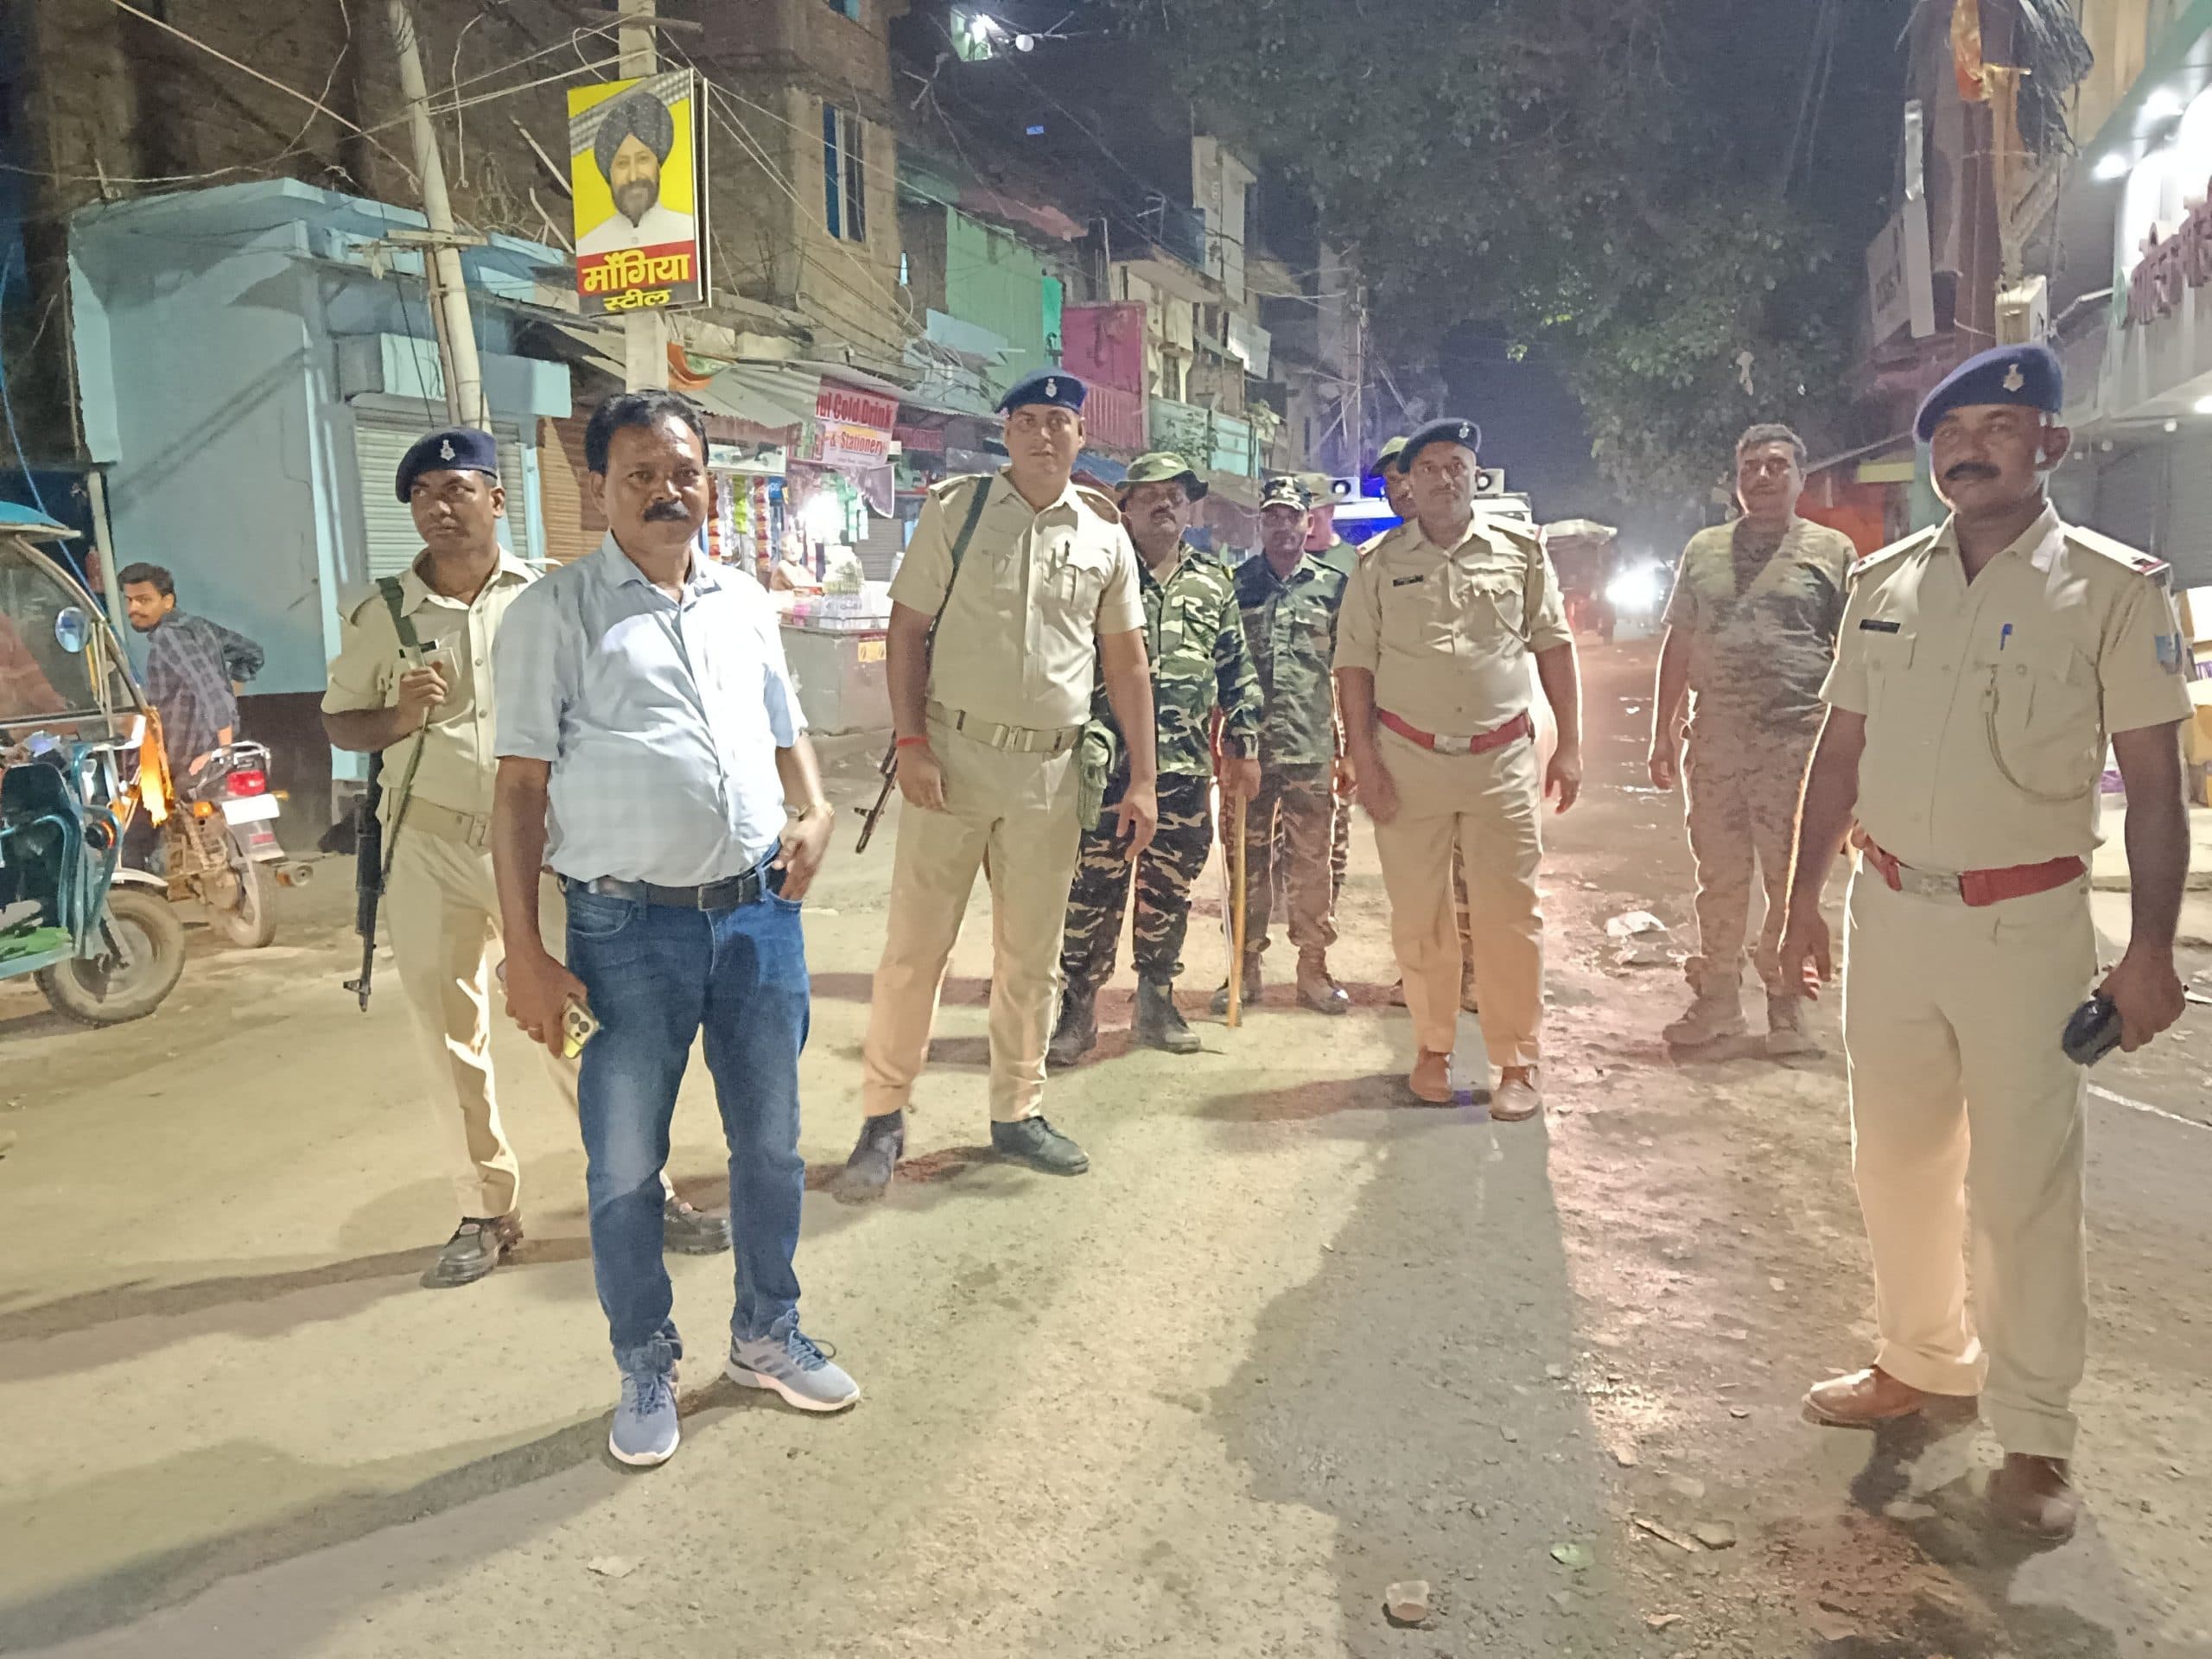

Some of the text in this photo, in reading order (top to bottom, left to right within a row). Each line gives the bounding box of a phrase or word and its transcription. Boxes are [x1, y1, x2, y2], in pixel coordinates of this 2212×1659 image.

[603, 289, 671, 311] स्टील
[834, 394, 860, 422] Cold
[862, 399, 893, 429] Drink
